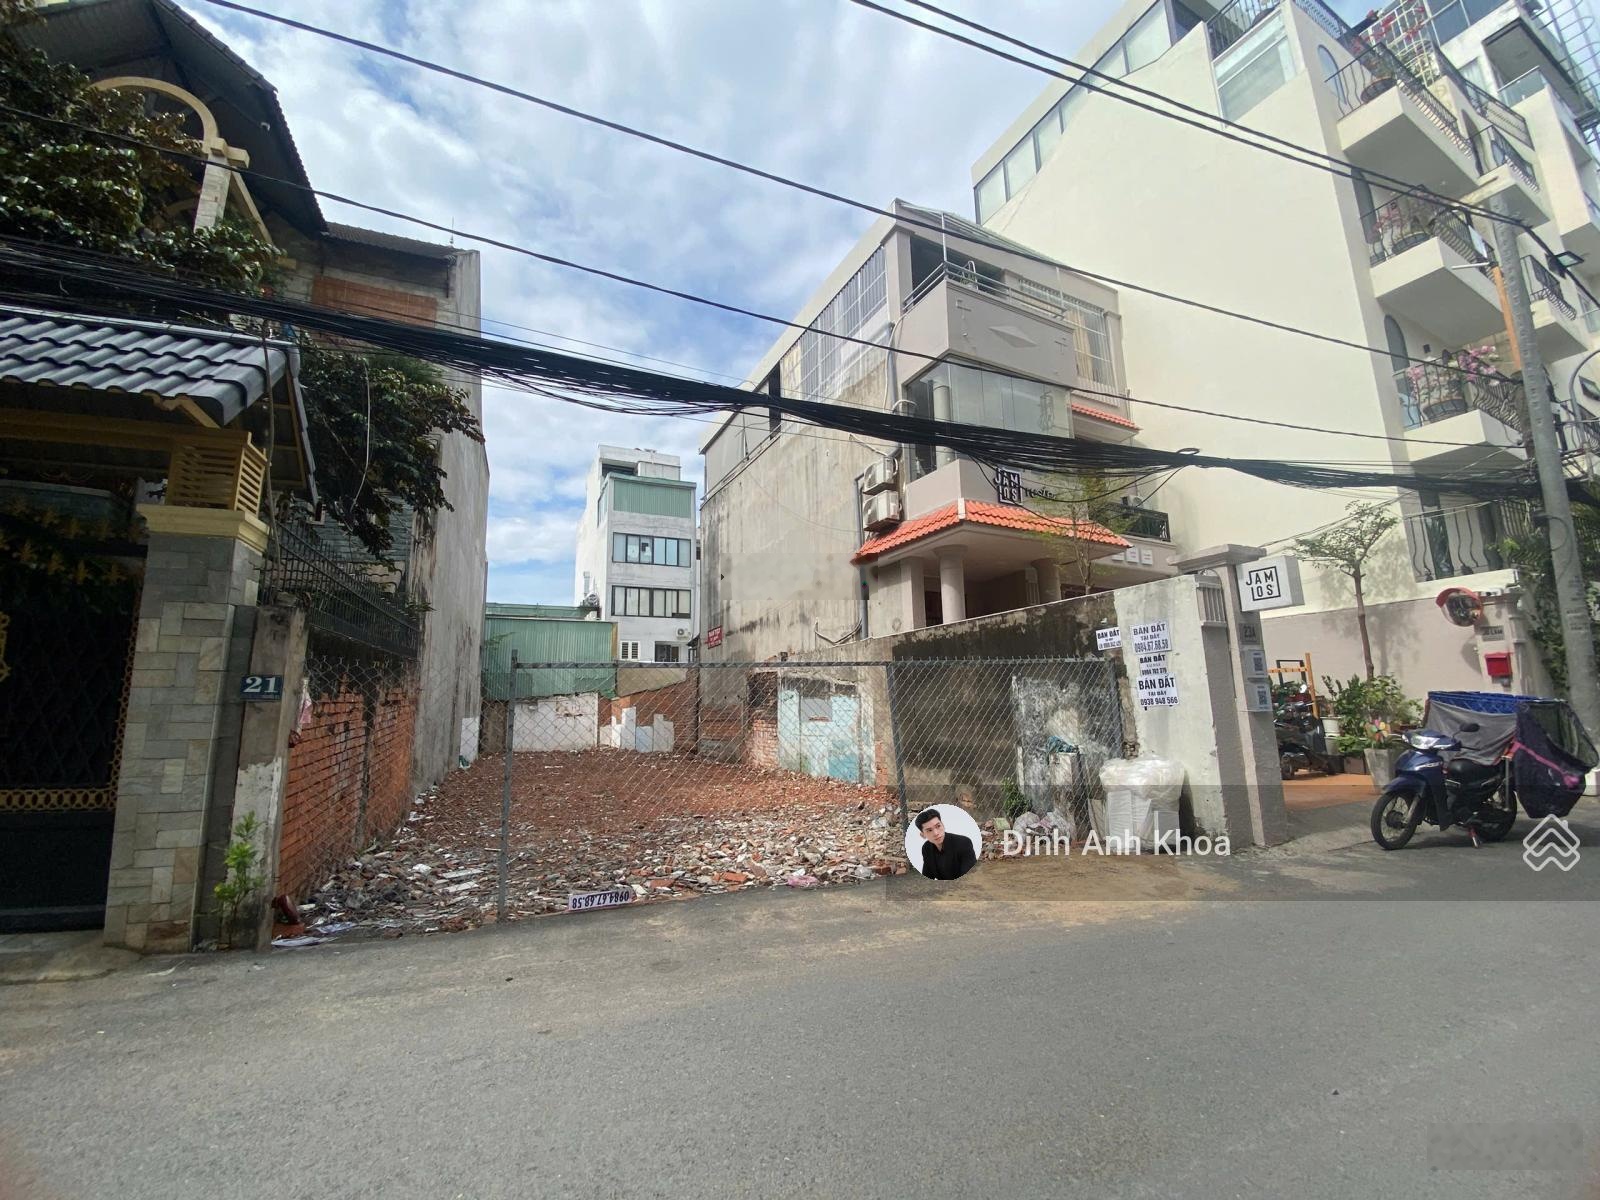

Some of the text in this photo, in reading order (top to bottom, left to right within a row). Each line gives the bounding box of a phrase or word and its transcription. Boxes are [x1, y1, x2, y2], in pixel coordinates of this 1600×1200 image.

[1246, 569, 1274, 586] JAM
[243, 676, 279, 693] 21
[1138, 675, 1175, 690] BÁN ĐẤT
